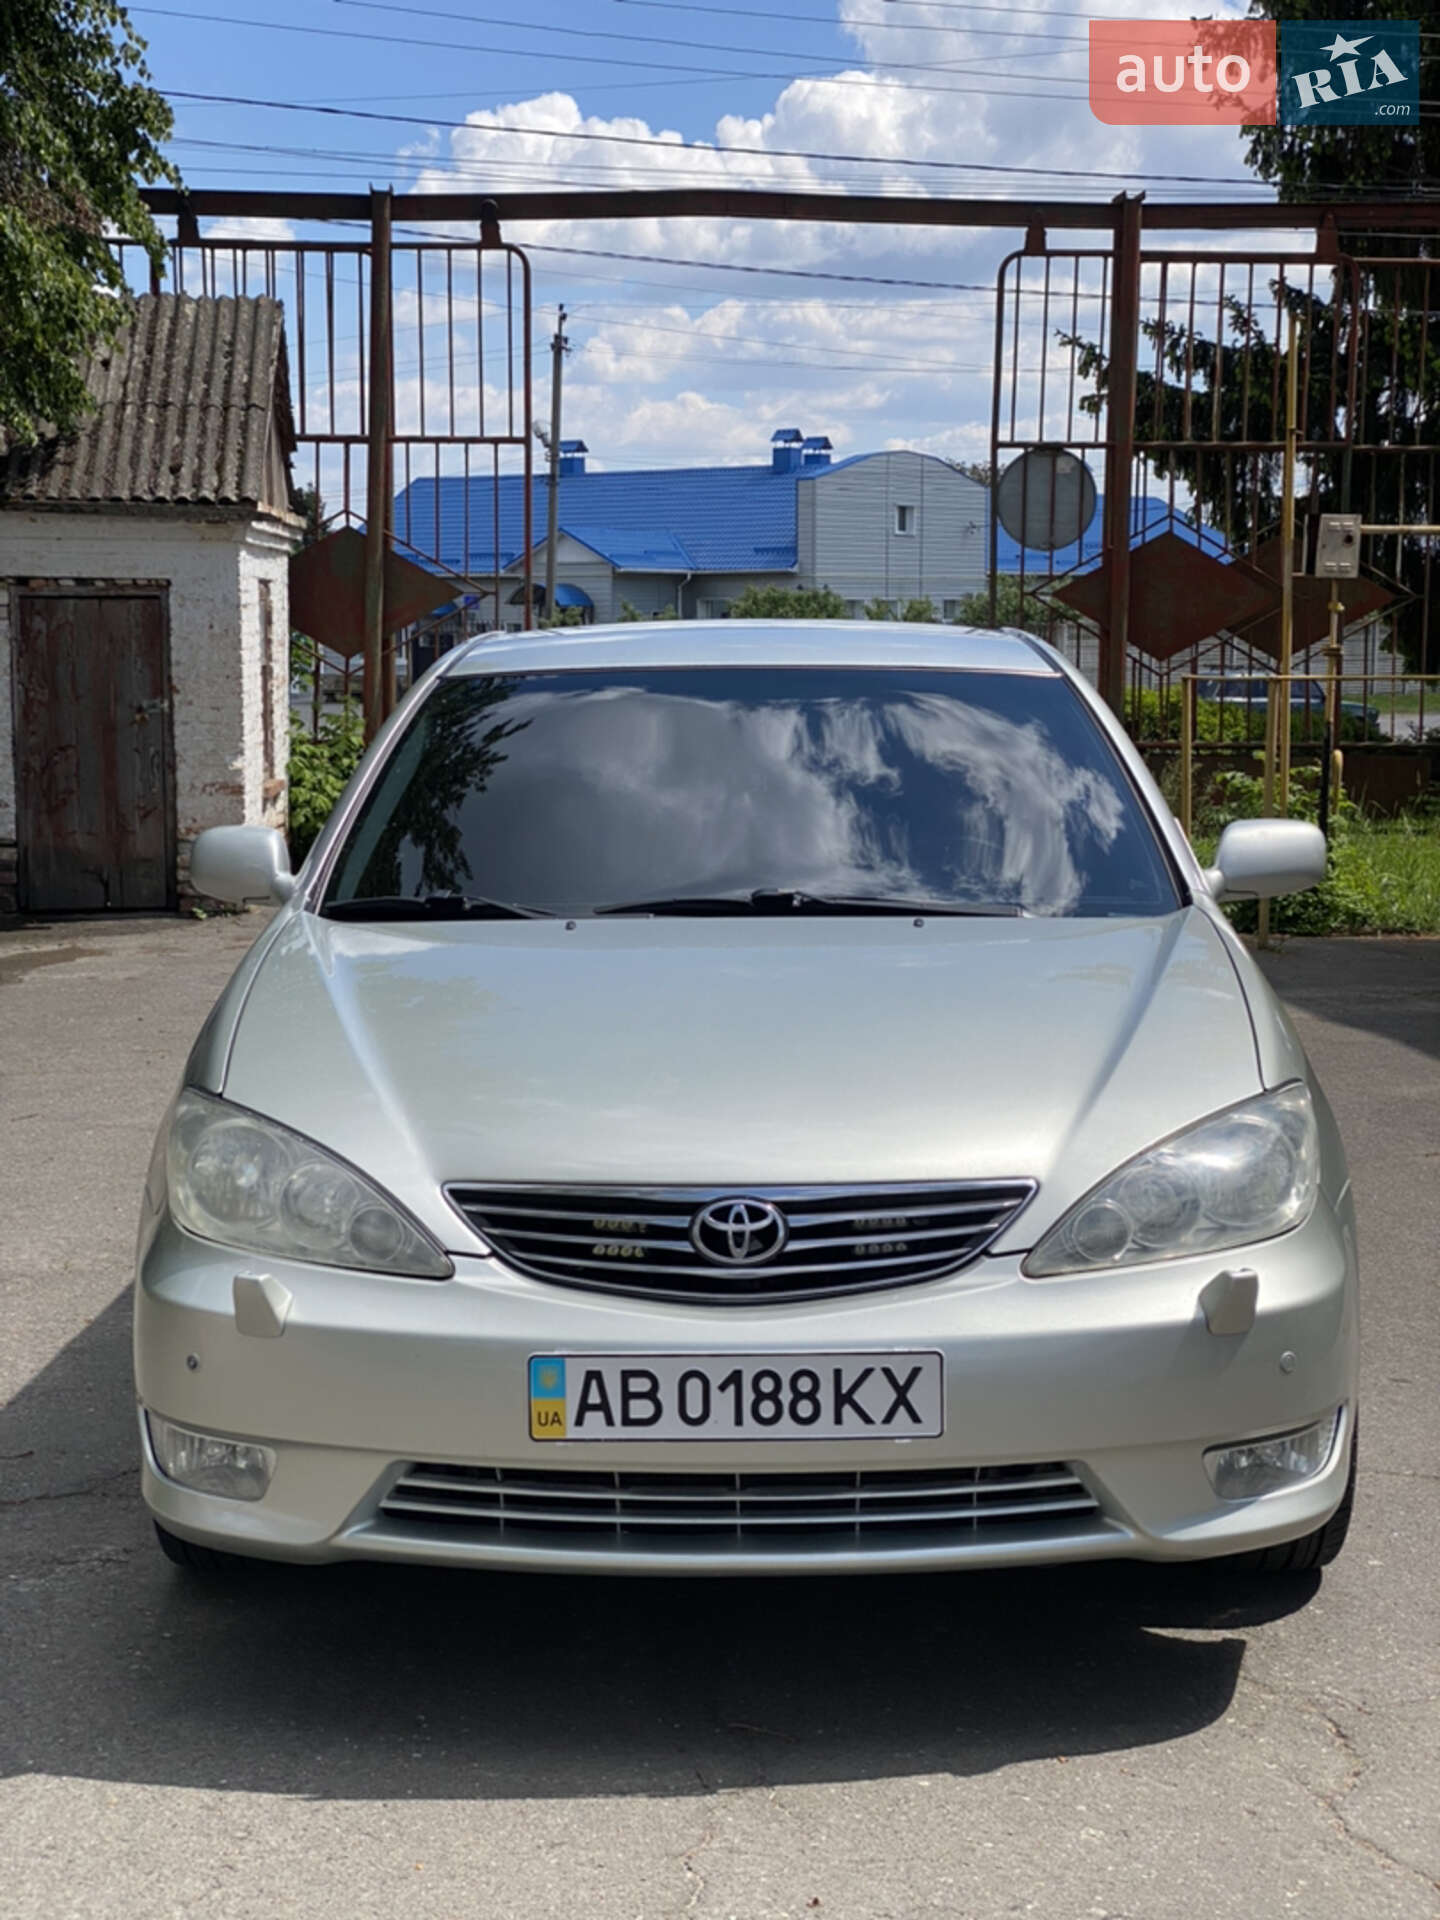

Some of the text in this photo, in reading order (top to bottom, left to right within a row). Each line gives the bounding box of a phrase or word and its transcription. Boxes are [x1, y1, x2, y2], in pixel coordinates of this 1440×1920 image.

[574, 1369, 663, 1427] AB
[677, 1368, 822, 1427] 0188
[537, 1411, 562, 1427] UA
